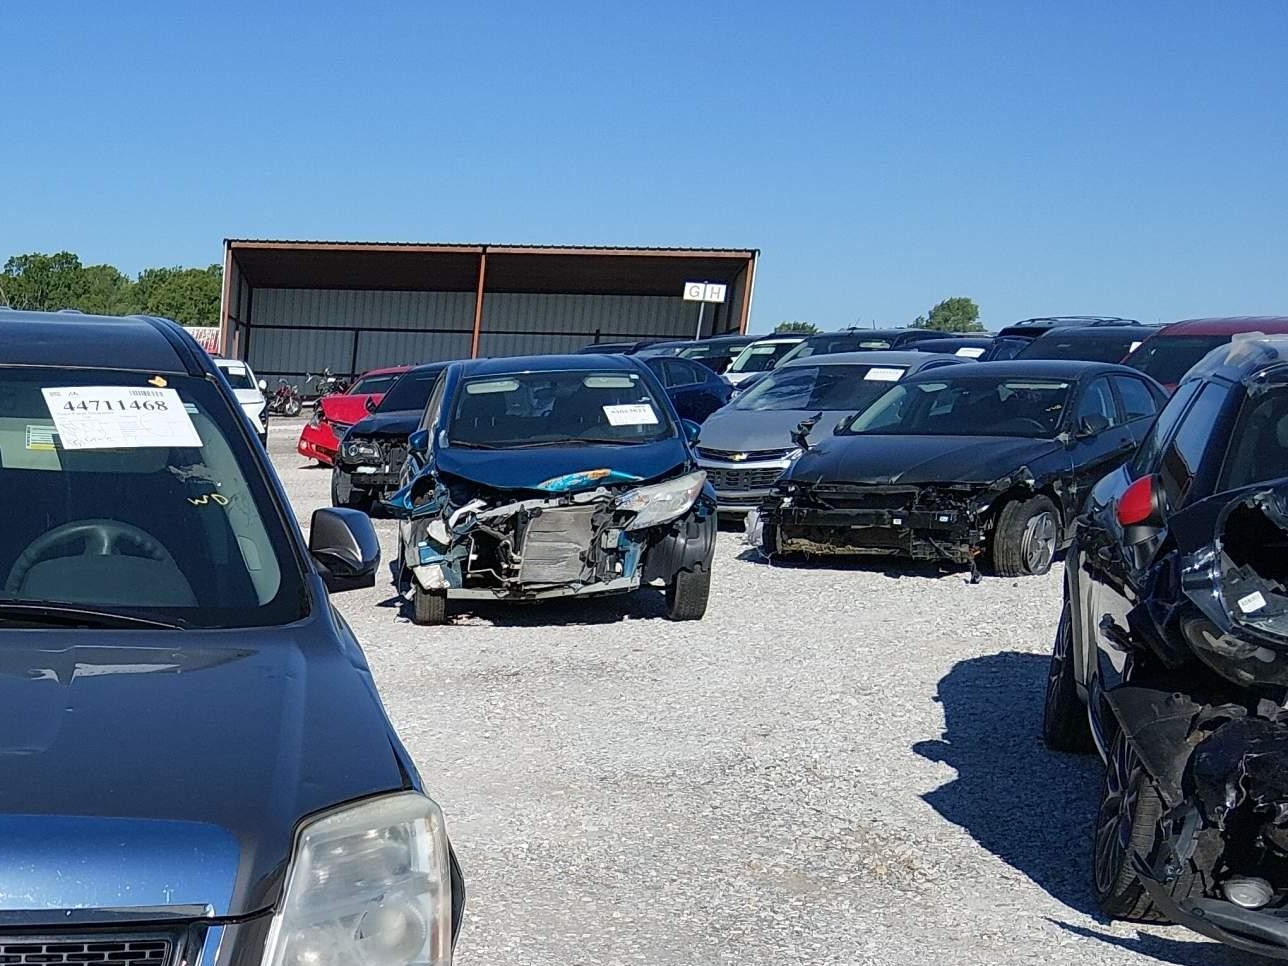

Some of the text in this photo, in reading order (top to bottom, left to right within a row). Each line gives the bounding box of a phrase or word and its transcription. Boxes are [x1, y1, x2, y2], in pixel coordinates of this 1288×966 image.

[689, 285, 721, 299] G H
[64, 400, 168, 411] 44711468
